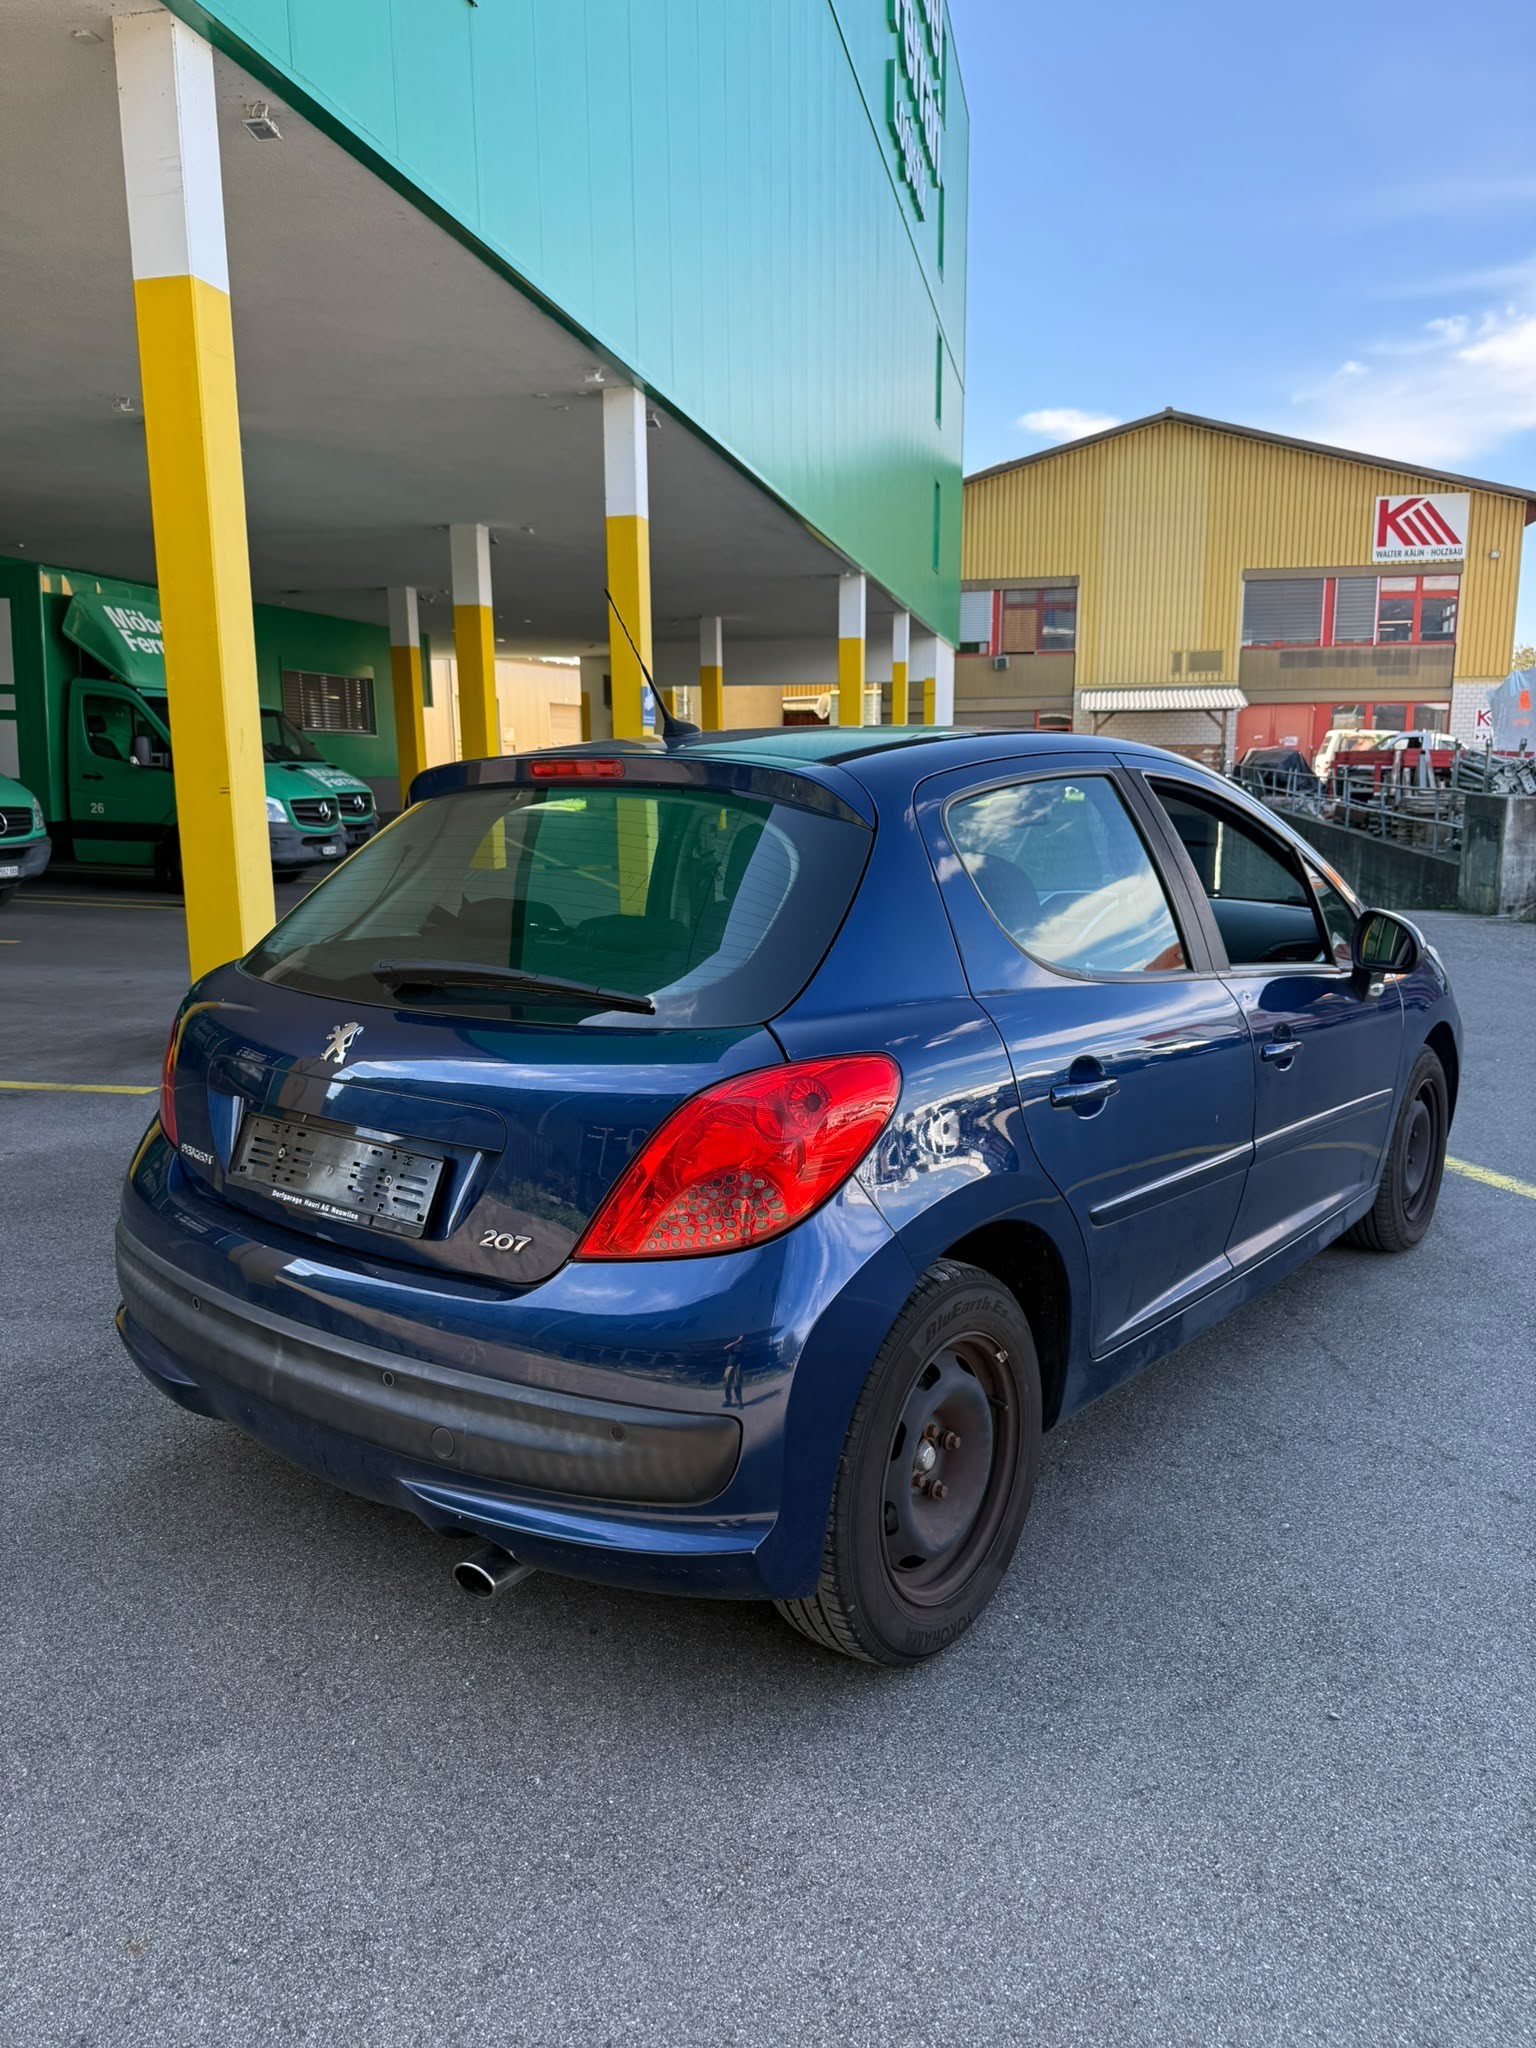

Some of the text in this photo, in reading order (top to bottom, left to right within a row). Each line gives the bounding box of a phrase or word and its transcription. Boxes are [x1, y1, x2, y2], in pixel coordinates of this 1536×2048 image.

[1376, 549, 1402, 558] WALTER
[1404, 547, 1425, 557] KÄLIN
[1431, 547, 1463, 556] HOLZBAU
[102, 605, 162, 634] Möb
[119, 629, 165, 655] Ferr
[90, 802, 105, 814] 26
[272, 1189, 303, 1205] Dorfgarage
[304, 1199, 321, 1209] Hauri
[320, 1204, 330, 1212] AG
[478, 1229, 532, 1254] 207
